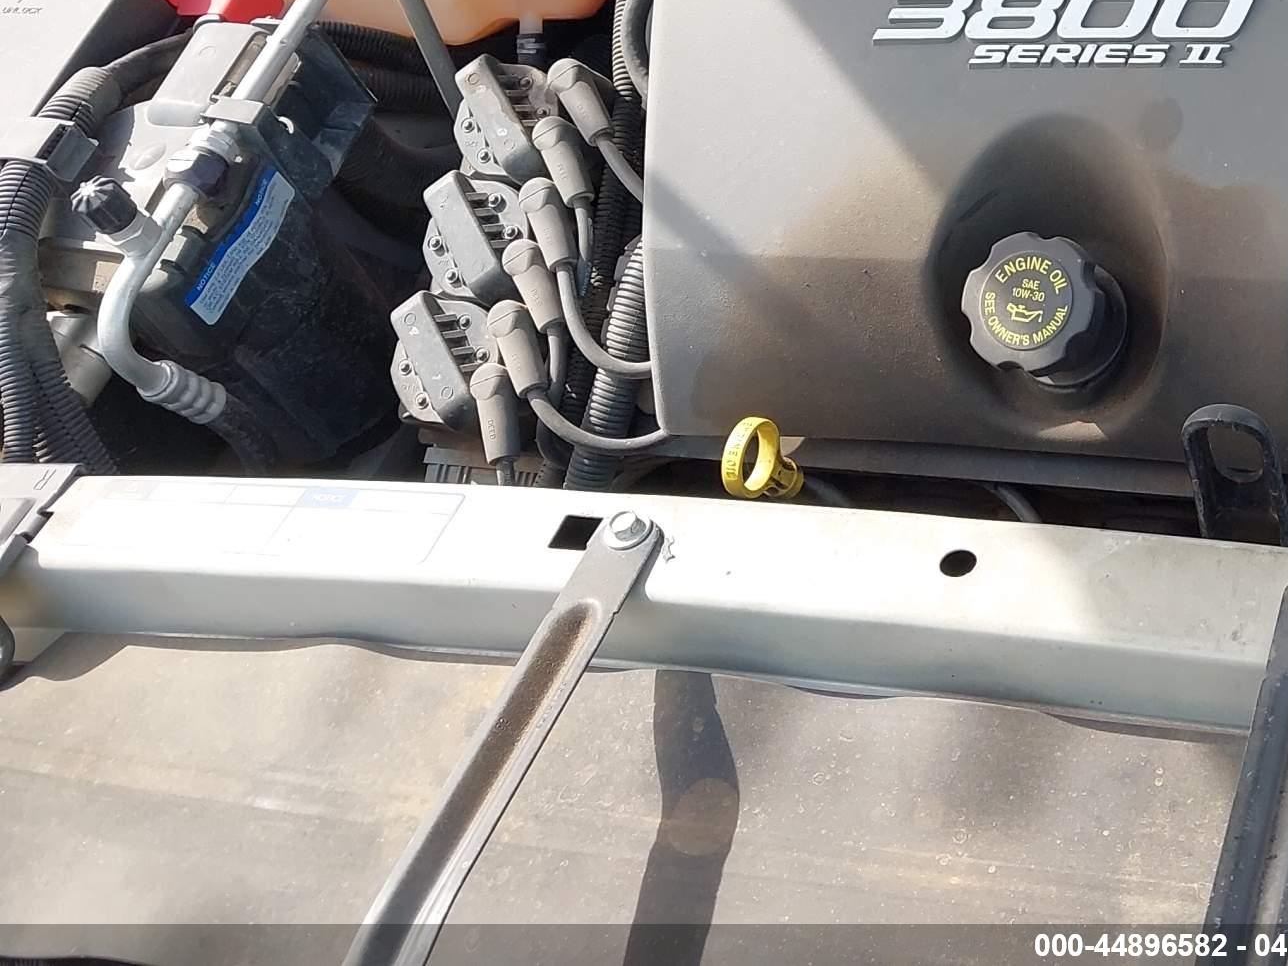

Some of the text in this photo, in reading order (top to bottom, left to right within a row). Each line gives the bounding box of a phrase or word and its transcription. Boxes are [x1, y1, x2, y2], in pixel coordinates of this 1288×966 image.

[968, 43, 1232, 67] SERIES II
[196, 263, 216, 291] NOTICE
[994, 256, 1068, 295] ENGINE OIL
[1021, 278, 1041, 291] SAE
[1012, 287, 1045, 302] 10W-30
[984, 292, 1069, 346] SEE OWNER'S MANUAL
